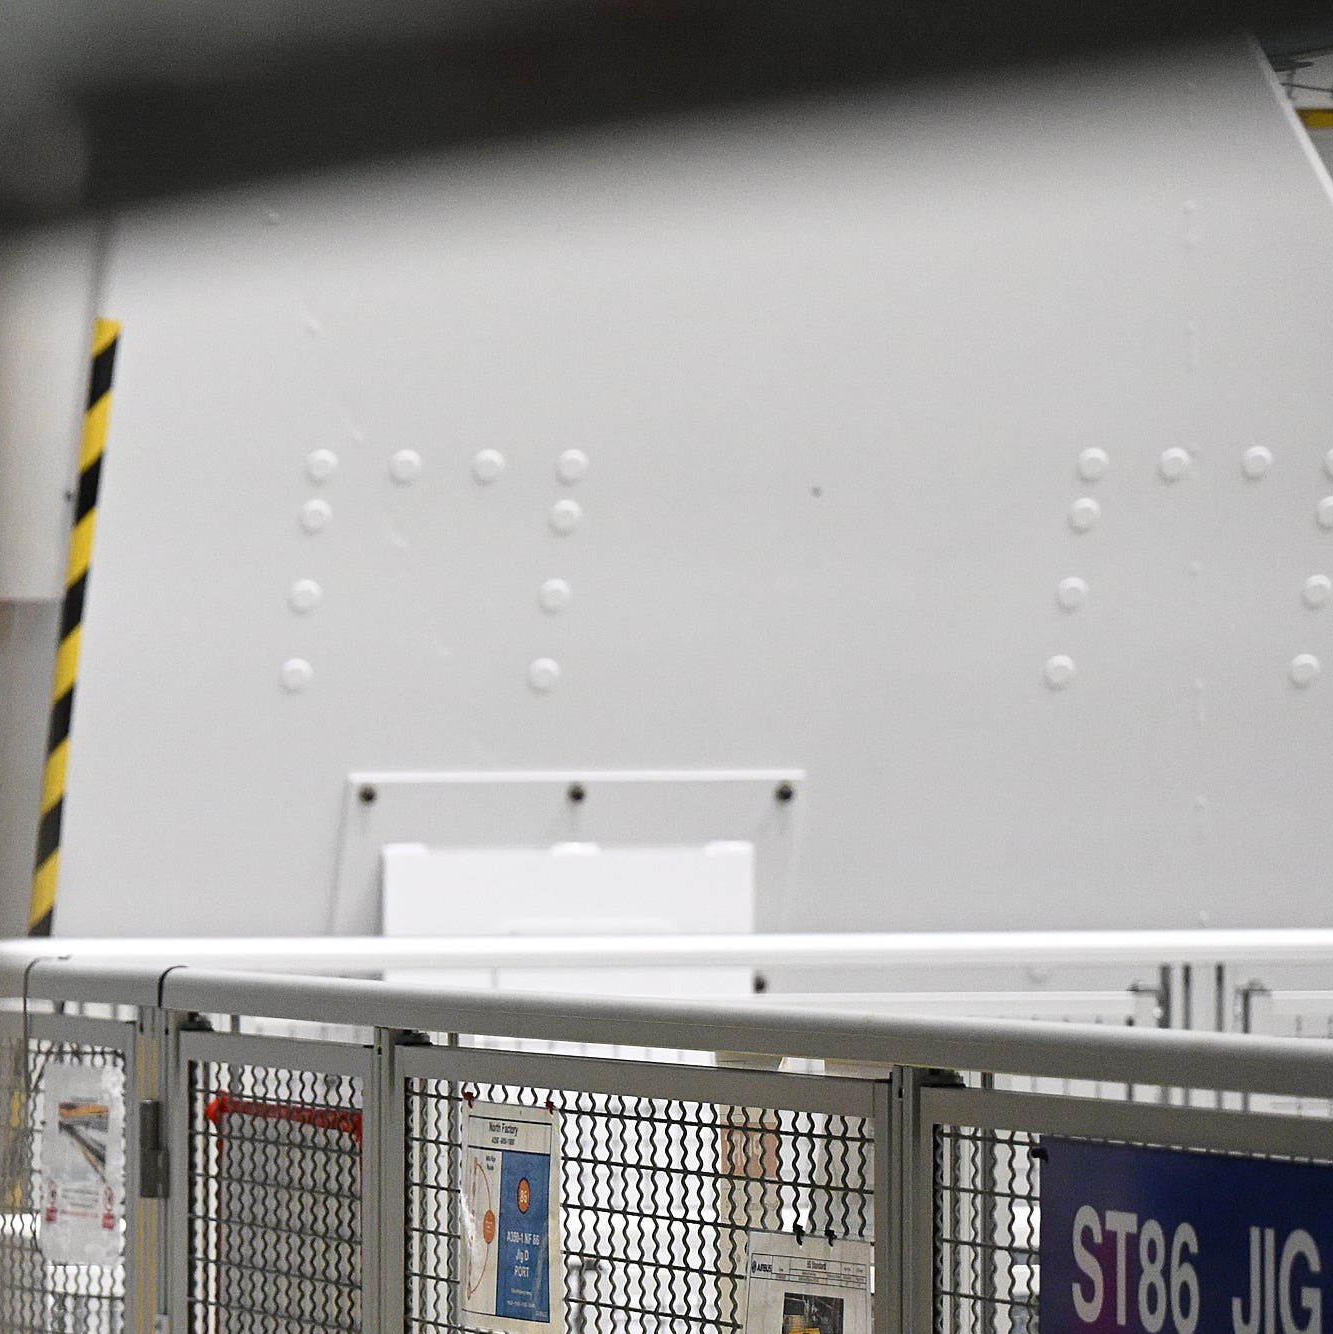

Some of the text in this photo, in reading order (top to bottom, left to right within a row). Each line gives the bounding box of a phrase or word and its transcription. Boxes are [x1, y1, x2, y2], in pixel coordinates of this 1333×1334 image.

[489, 1122, 518, 1137] North Factory
[514, 1266, 530, 1278] PORT
